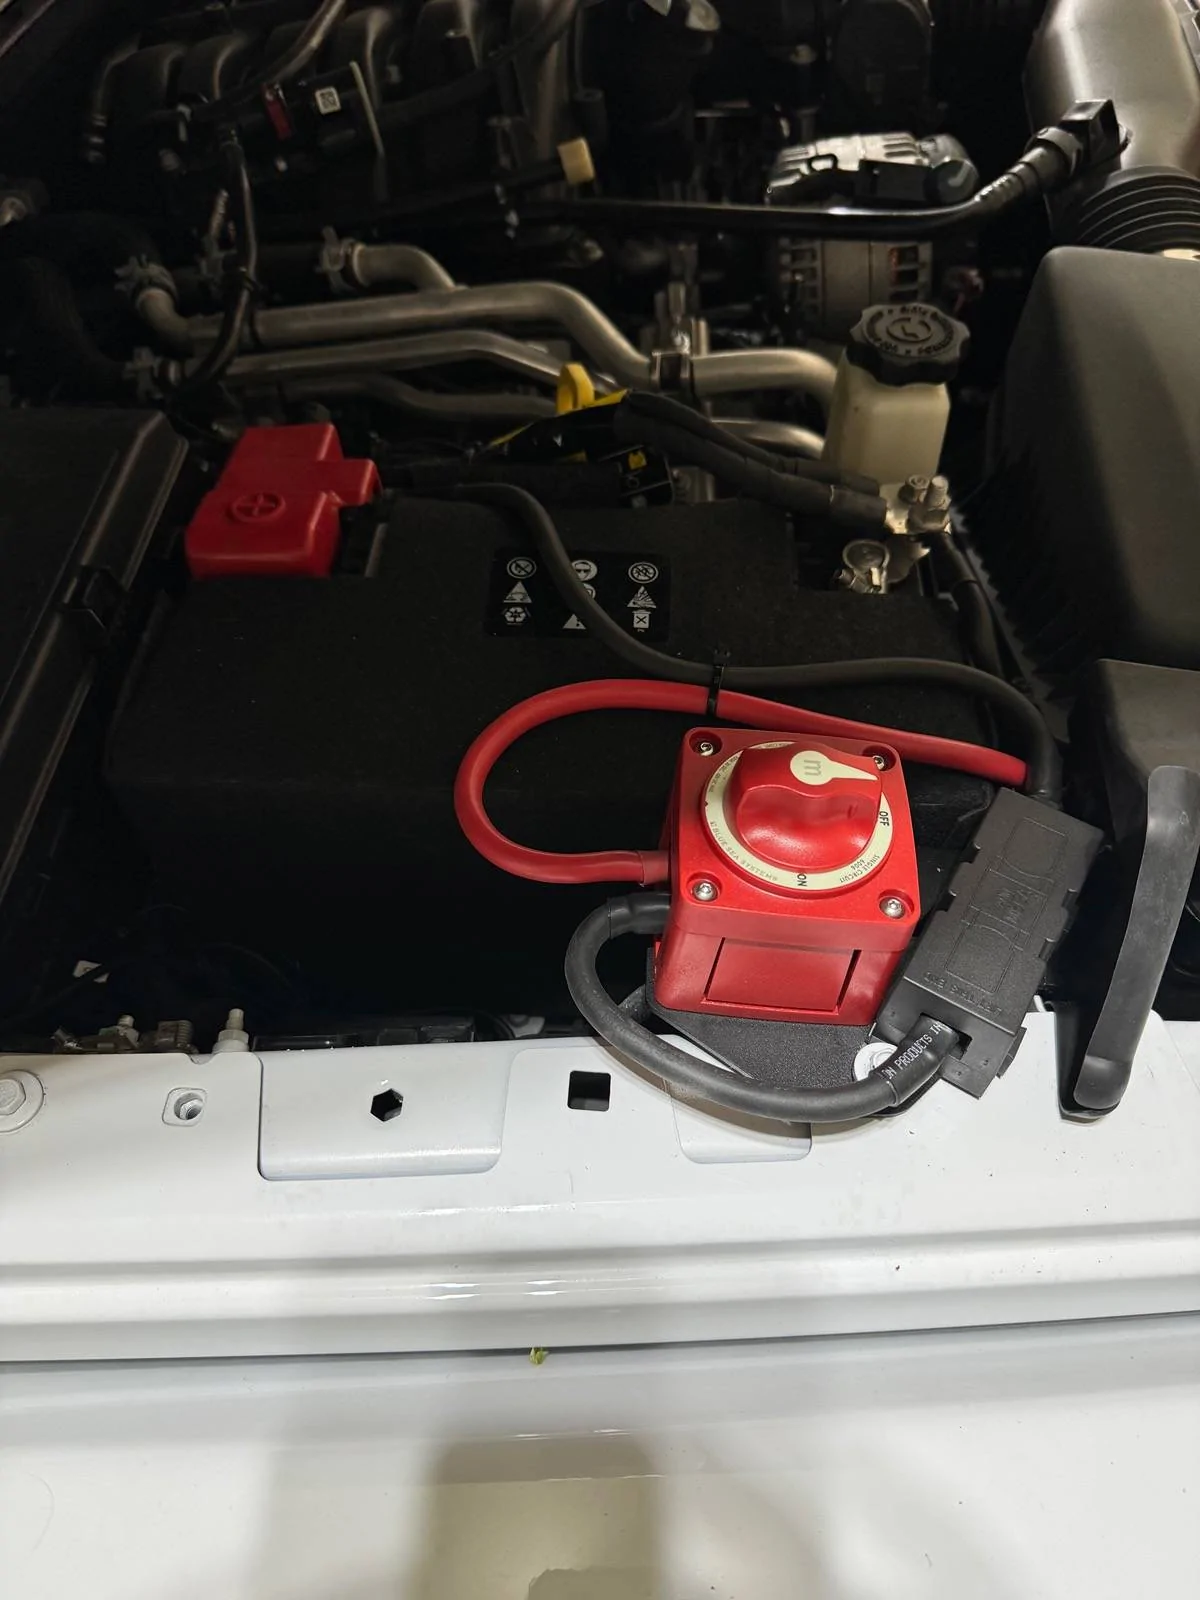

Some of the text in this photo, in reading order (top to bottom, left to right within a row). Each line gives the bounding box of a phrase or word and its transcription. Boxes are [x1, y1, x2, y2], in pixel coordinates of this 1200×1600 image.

[878, 810, 890, 827] OFF
[796, 873, 808, 887] ON
[893, 1034, 933, 1071] PRODUCTS
